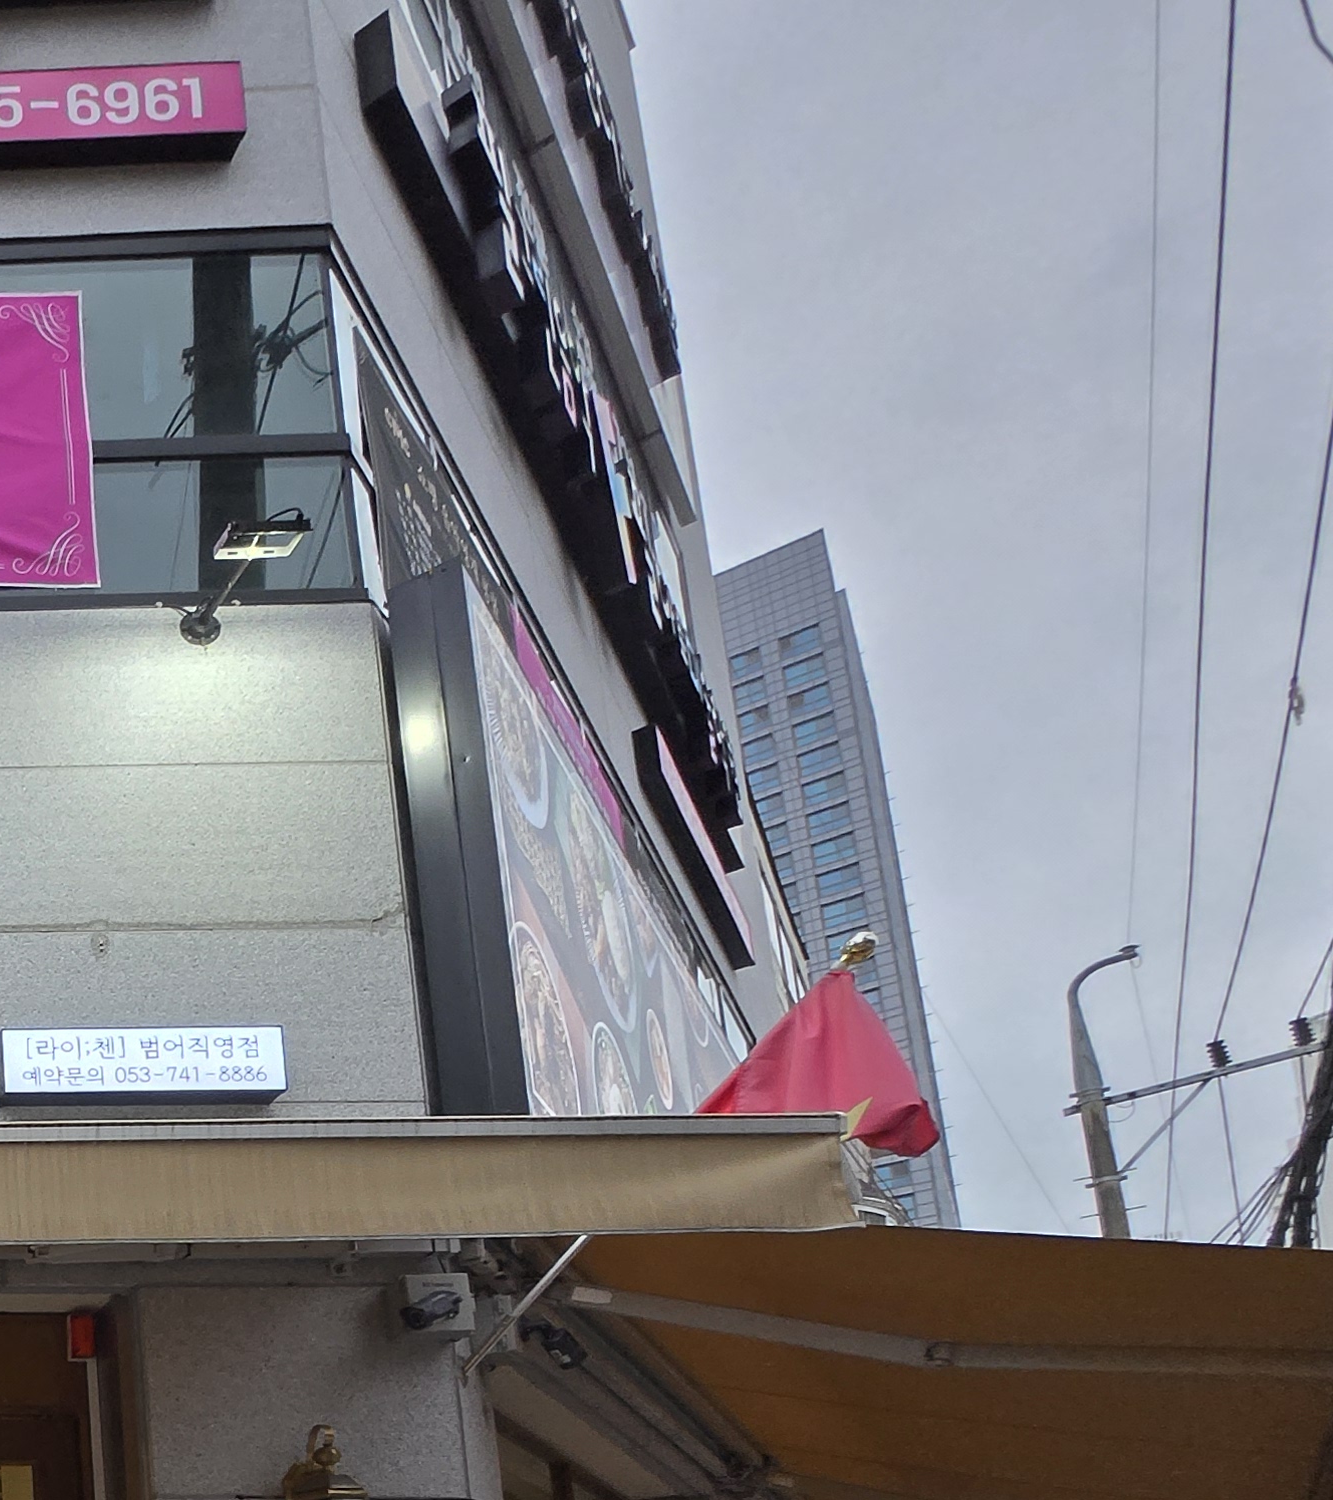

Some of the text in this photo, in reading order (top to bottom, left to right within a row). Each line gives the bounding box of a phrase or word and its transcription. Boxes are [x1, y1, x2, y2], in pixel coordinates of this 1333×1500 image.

[140, 1035, 260, 1060] 범어직영점
[22, 1066, 268, 1086] 예약문의 053-741-8886
